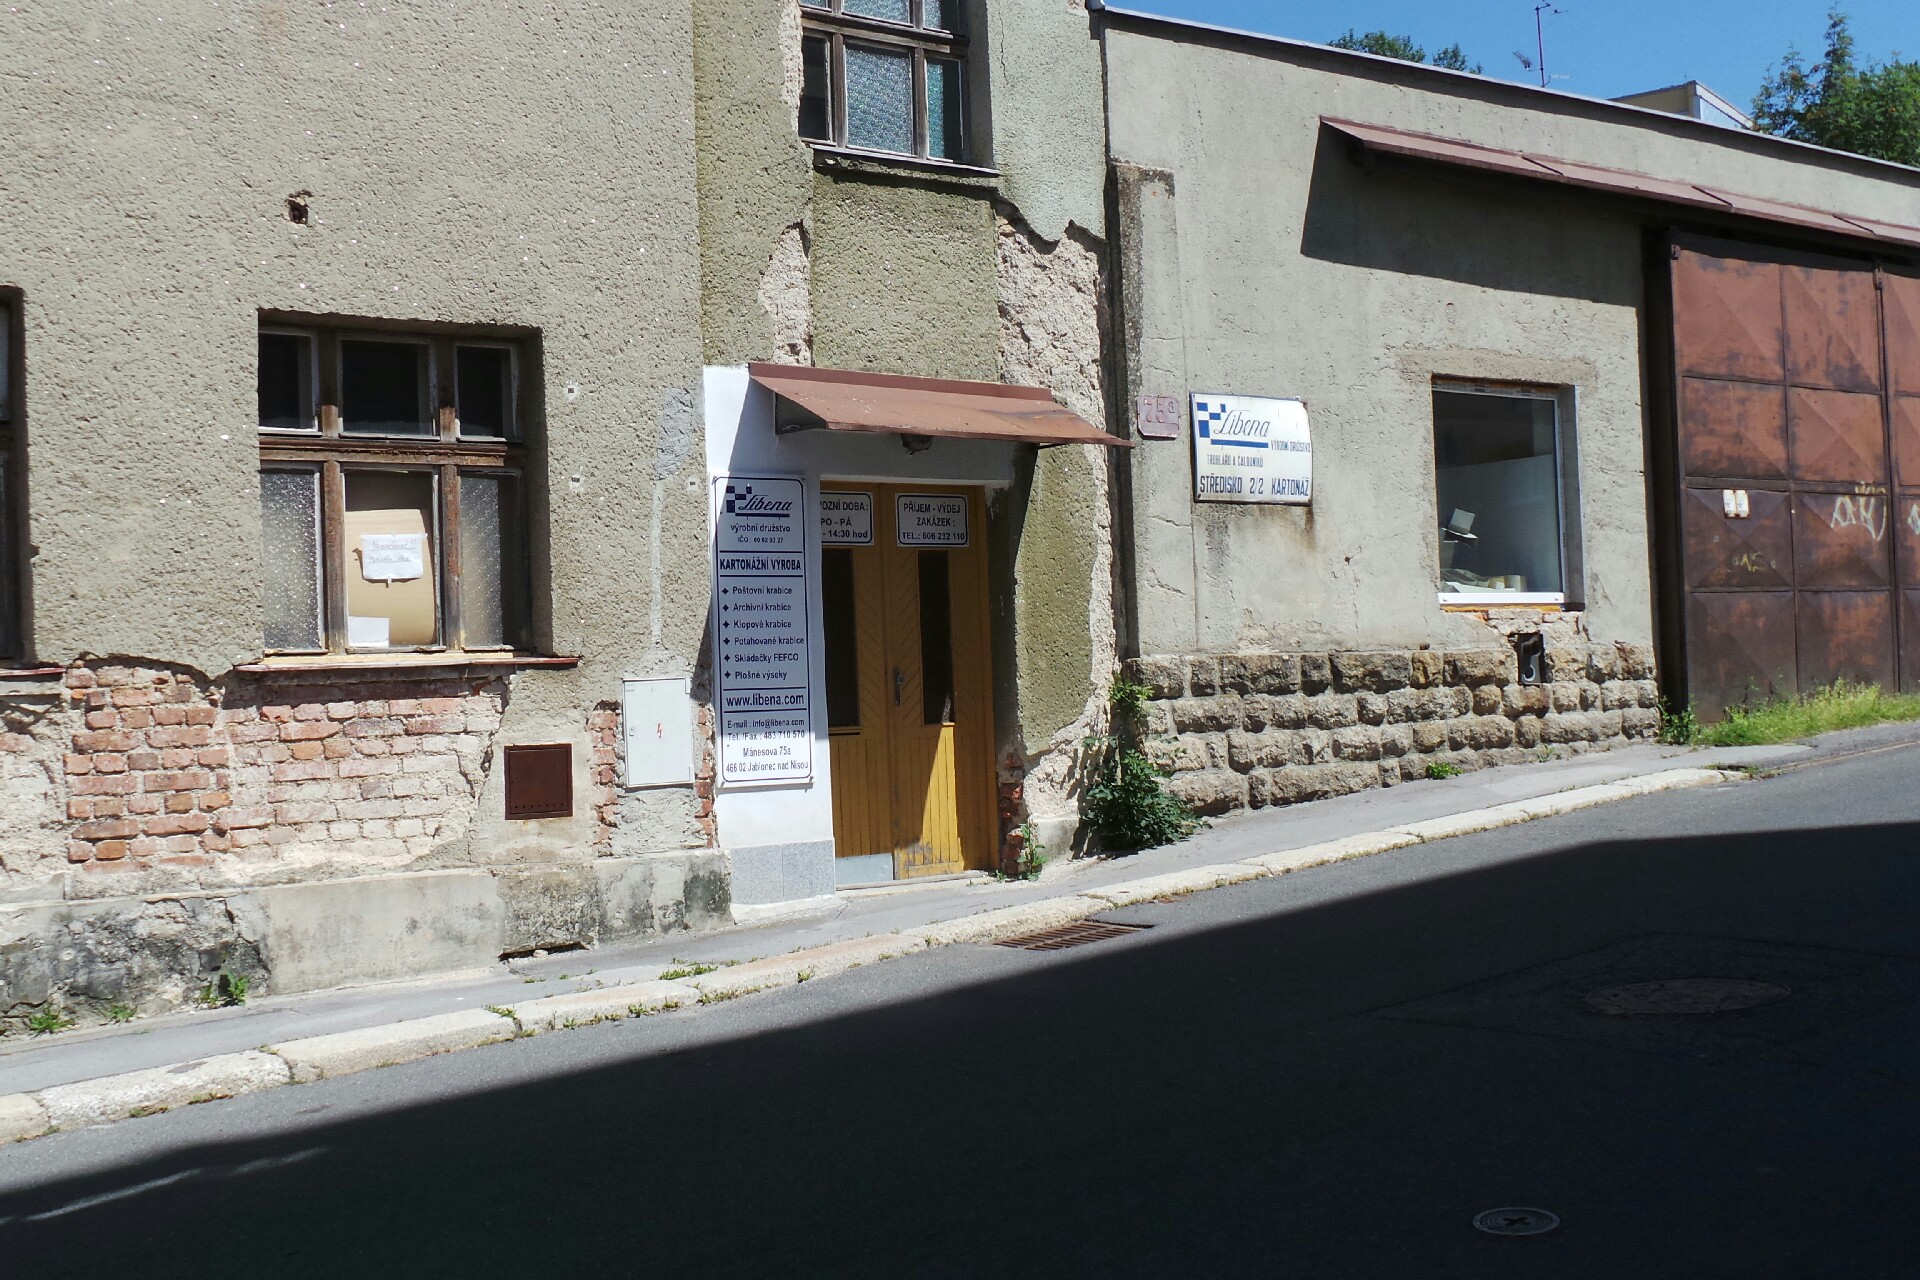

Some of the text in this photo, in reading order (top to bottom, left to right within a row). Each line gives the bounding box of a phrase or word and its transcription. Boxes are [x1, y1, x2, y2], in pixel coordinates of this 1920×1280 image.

[1214, 409, 1270, 438] Libena
[1200, 473, 1243, 494] STŘEDISKO
[1271, 477, 1309, 497] KARTONÁŽ
[738, 495, 793, 511] Libena
[820, 499, 841, 511] OZNÍ
[903, 501, 931, 513] PŘÍJEM
[937, 501, 961, 514] VÝDEJ
[820, 517, 833, 526] PO
[840, 516, 852, 527] PÁ
[916, 515, 951, 526] ZAKÁZEK
[730, 523, 791, 533] výrobní družstvo
[828, 529, 850, 538] 14:30
[852, 529, 868, 538] hod
[922, 531, 936, 540] 606
[937, 532, 951, 540] 232
[952, 532, 965, 541] 110
[719, 556, 802, 571] KARTONÁŽNÍ VÝROBA
[732, 586, 793, 595] Poštovní krabice
[733, 602, 792, 611] Archivní krabice
[733, 619, 792, 630] Klopové krabice
[734, 636, 805, 645] Potahované krabice
[734, 653, 799, 664] Skládačky FEFCO
[735, 669, 787, 680] Plošné výseky
[726, 693, 804, 706] www.libena.com
[727, 720, 748, 728] E-mail
[752, 719, 805, 728] info@libena.com
[763, 731, 776, 740] 483
[777, 730, 791, 740] 710
[792, 729, 805, 738] 570
[743, 746, 778, 757] Mánesova
[726, 759, 809, 774] 466 02 Jablonec nad Nisou
